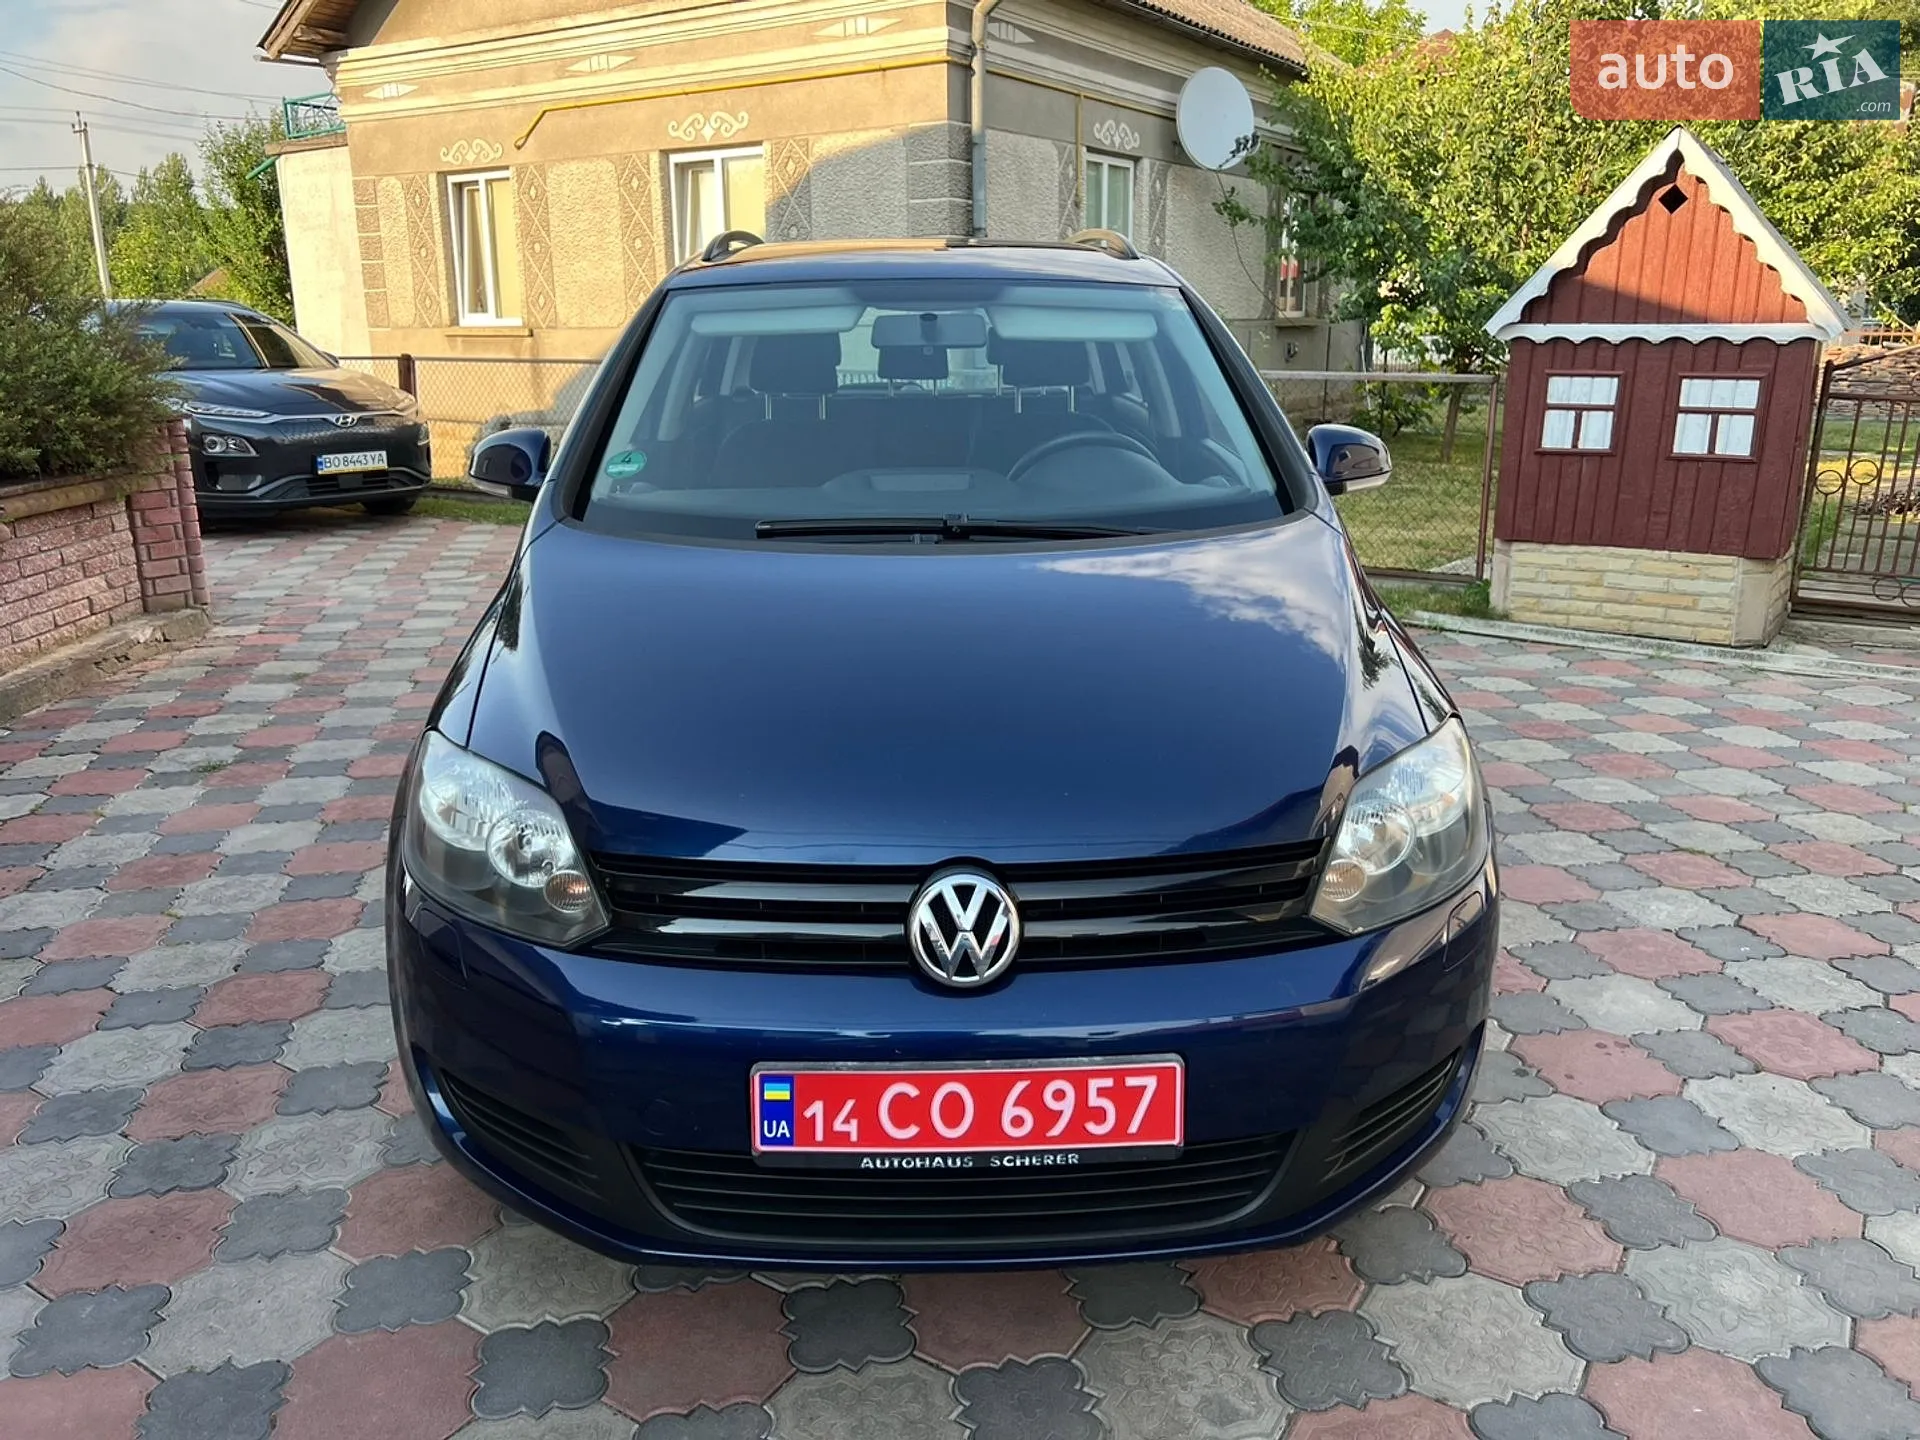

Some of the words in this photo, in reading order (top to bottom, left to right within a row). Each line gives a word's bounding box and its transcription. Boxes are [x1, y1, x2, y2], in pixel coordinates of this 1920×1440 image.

[323, 456, 341, 469] BO
[342, 454, 368, 467] 8443
[369, 453, 385, 465] YA
[621, 450, 632, 464] 4
[763, 1120, 791, 1138] UA
[803, 1099, 858, 1142] 14
[877, 1082, 975, 1140] CO
[1001, 1076, 1158, 1138] 6957
[860, 1156, 974, 1169] AUTOHAUS
[990, 1153, 1080, 1168] SCHERER
